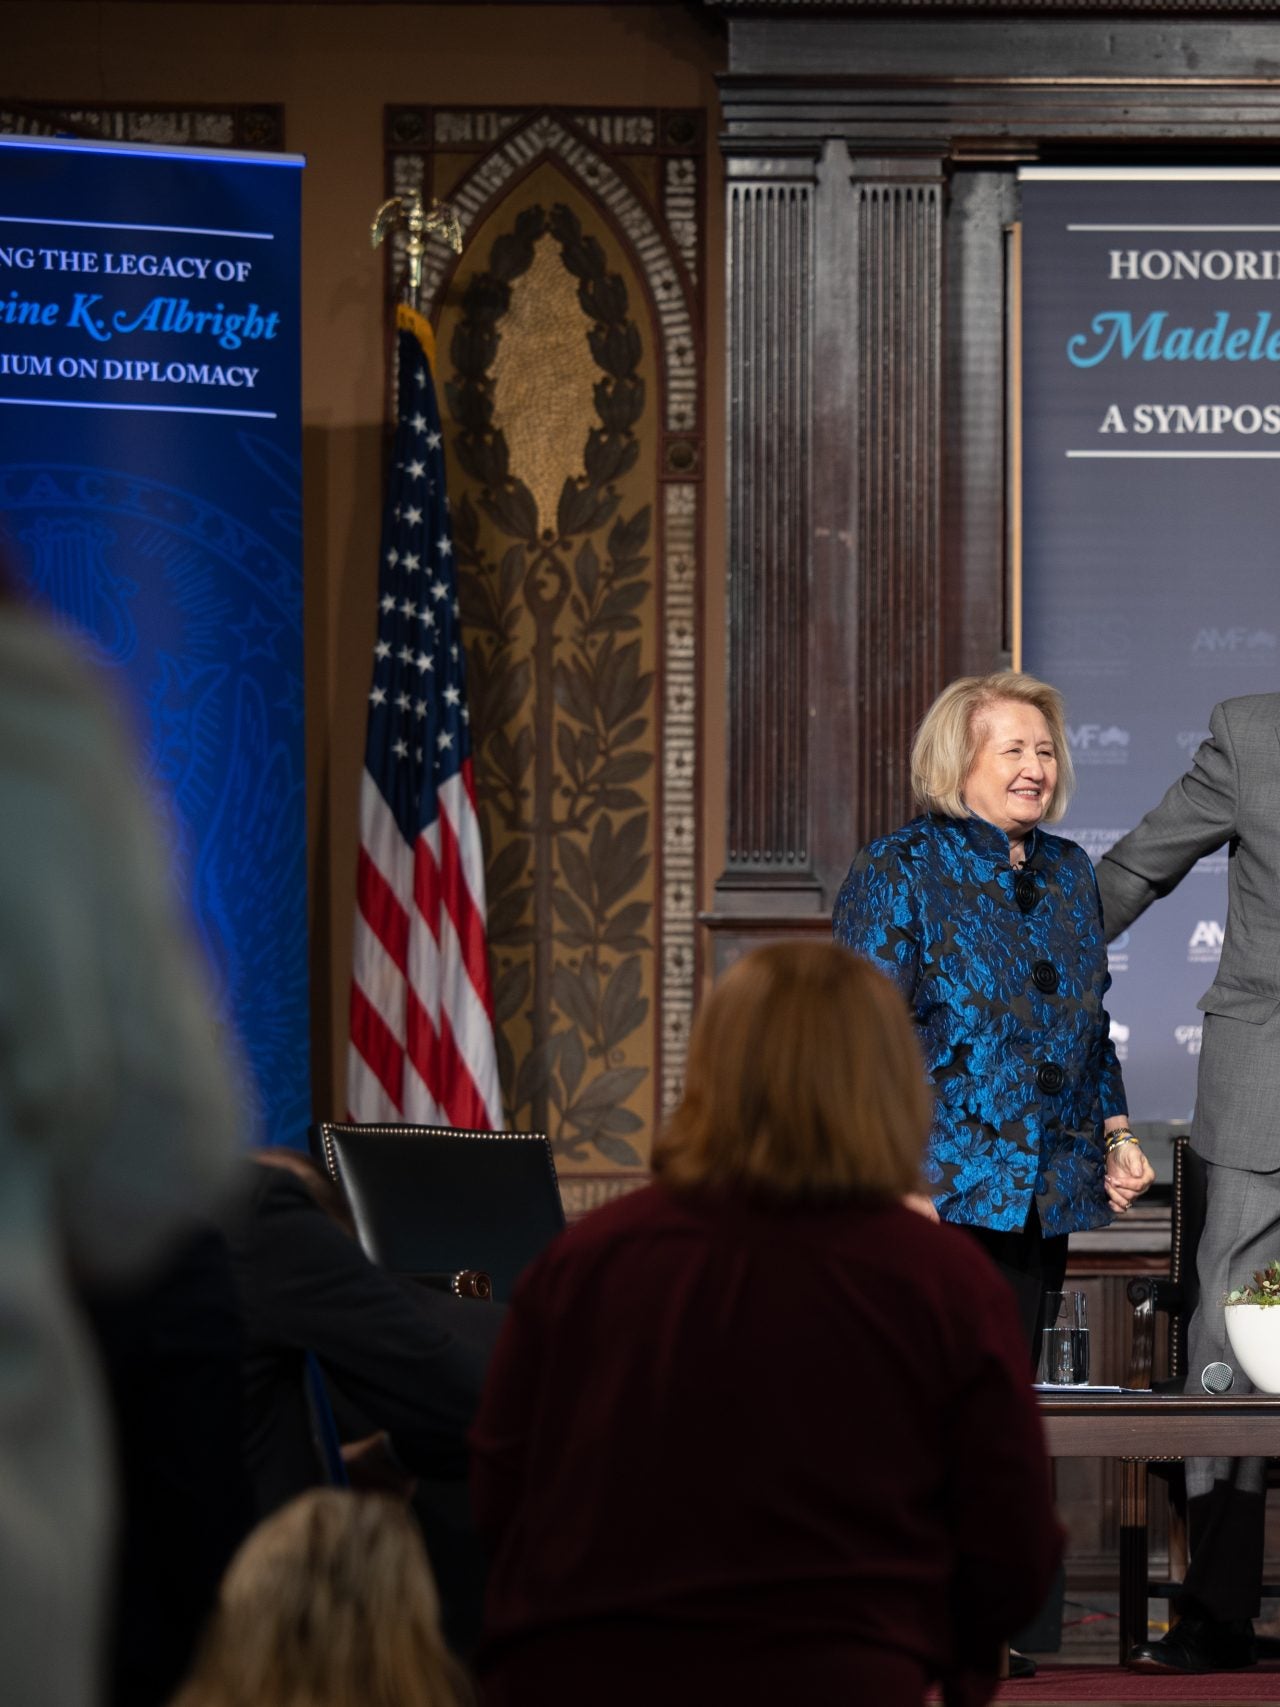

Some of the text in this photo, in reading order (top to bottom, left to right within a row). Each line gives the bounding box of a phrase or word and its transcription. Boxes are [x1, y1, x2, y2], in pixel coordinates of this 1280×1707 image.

[40, 249, 98, 273] THE
[104, 253, 211, 280] LEGACY
[215, 260, 252, 282] OF
[67, 293, 111, 342] K.
[113, 297, 279, 350] Albright
[58, 357, 98, 379] ON
[104, 359, 259, 388] DIPLOMACY
[1098, 404, 1128, 435] A
